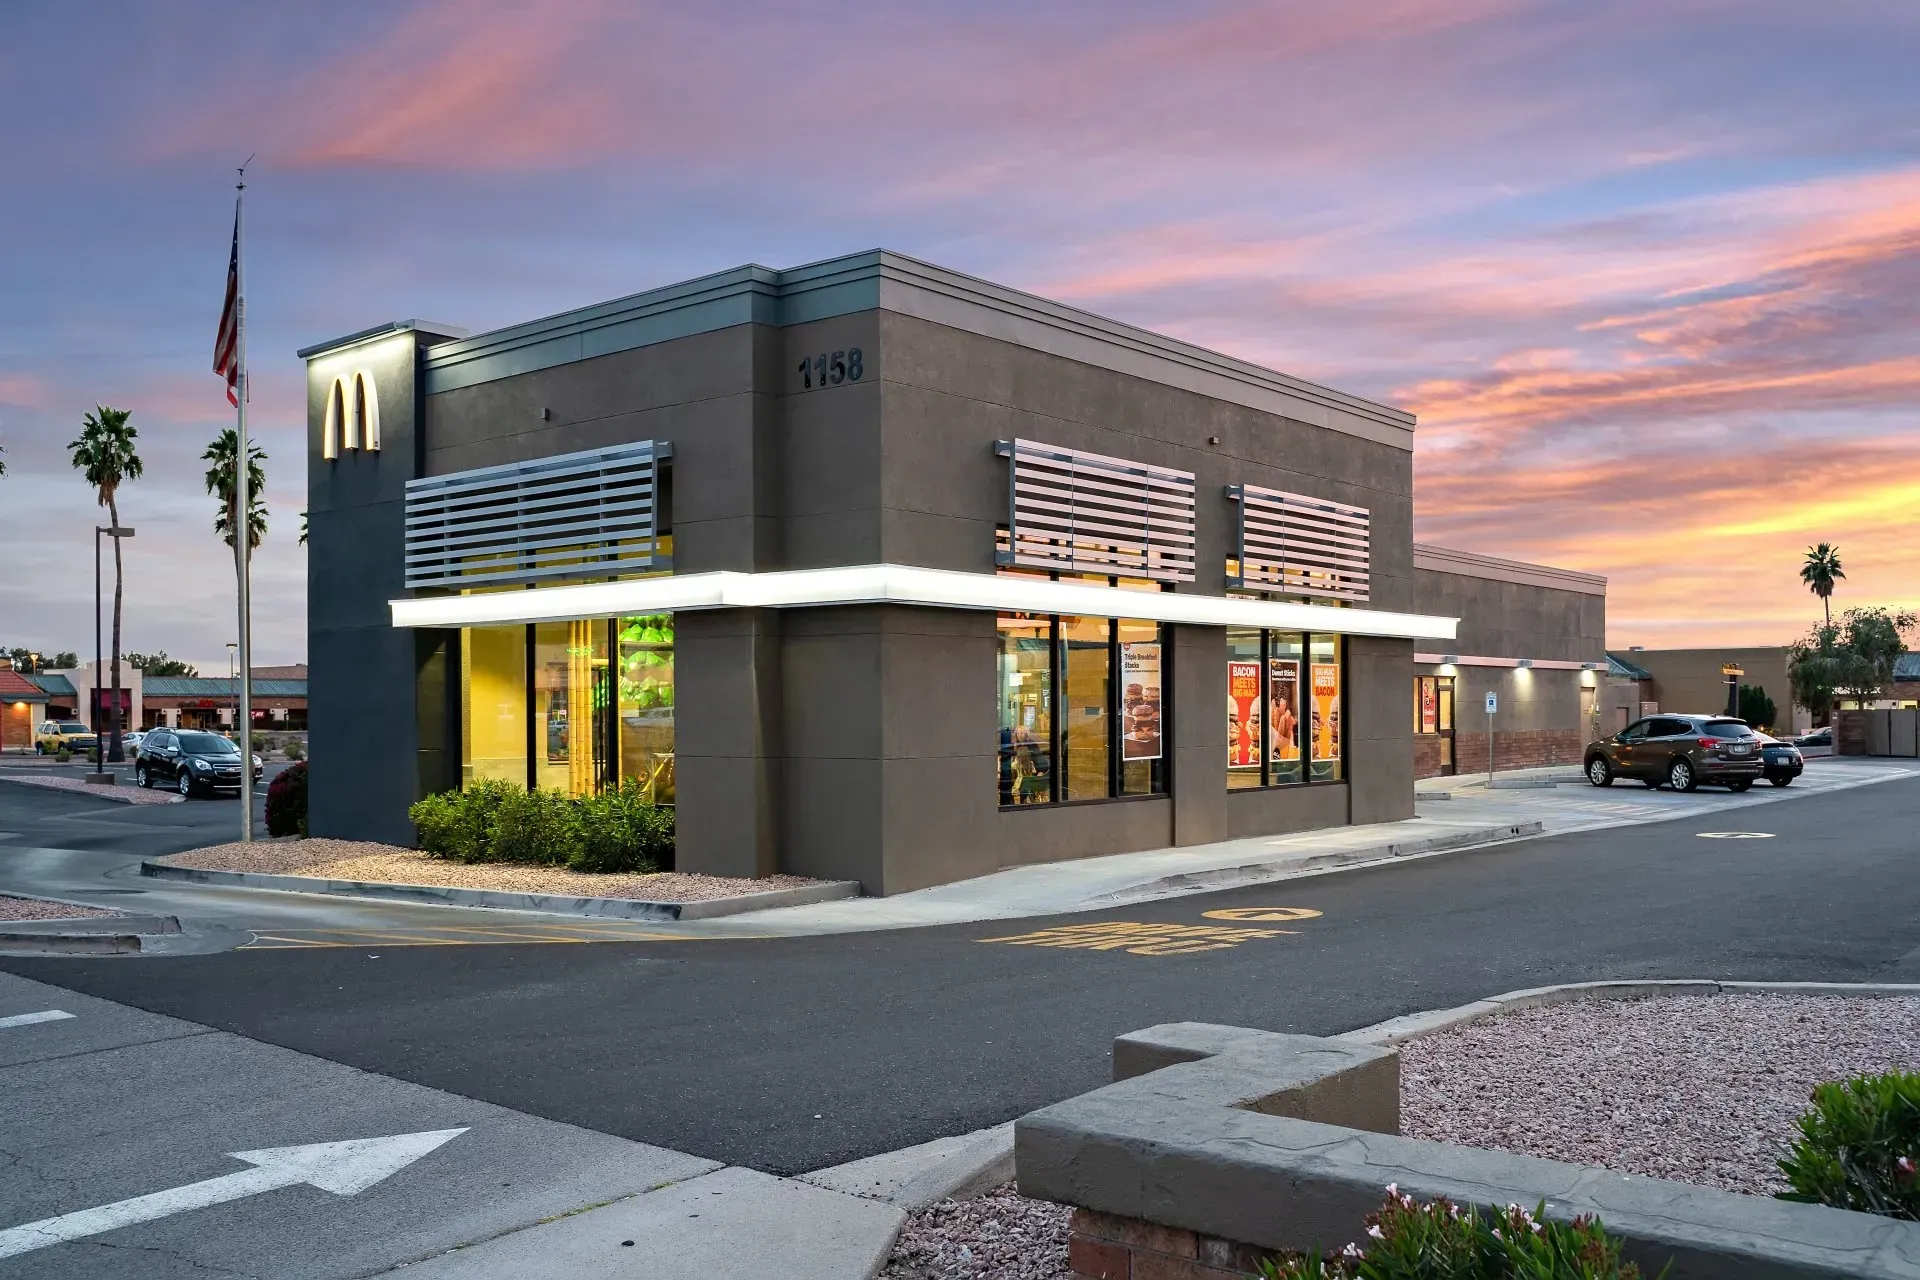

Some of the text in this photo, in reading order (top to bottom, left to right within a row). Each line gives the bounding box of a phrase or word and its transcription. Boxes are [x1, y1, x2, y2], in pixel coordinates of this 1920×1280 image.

[798, 347, 864, 389] 1158
[1125, 653, 1158, 661] Triple Breakfast
[1232, 666, 1256, 677] BACON
[1271, 669, 1296, 677] Donut Sticks
[1315, 667, 1335, 676] BIG MAC
[1232, 677, 1256, 689] MEETS
[1315, 676, 1335, 687] MEETS
[1233, 688, 1256, 697] BIG MAC
[1315, 686, 1335, 697] BACON
[971, 931, 1239, 956] THRU
